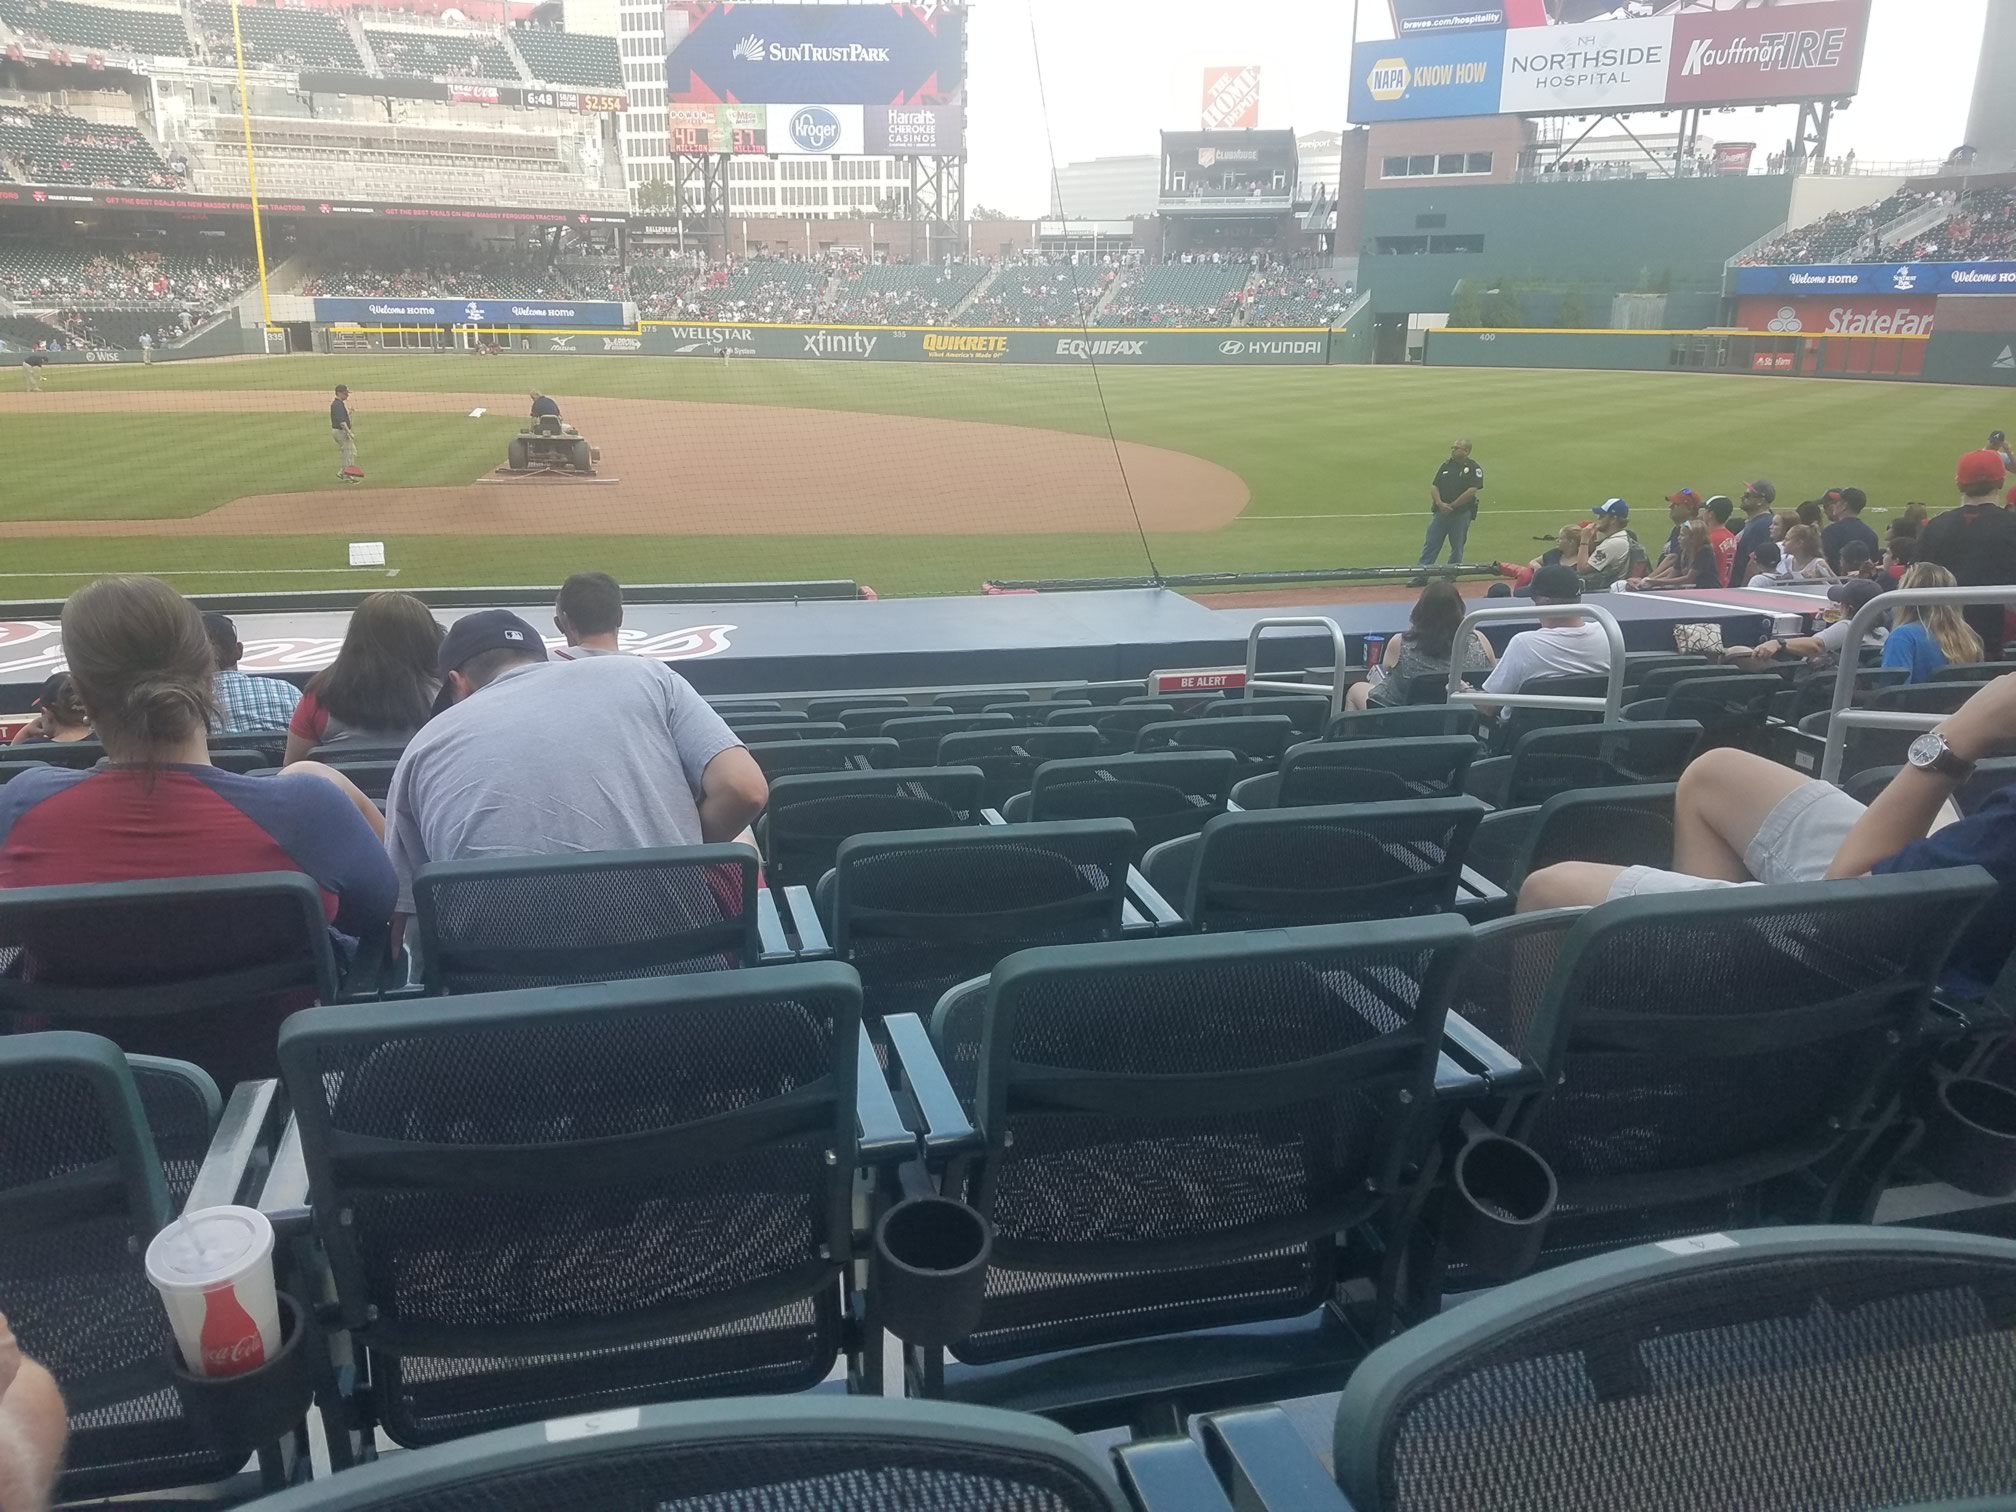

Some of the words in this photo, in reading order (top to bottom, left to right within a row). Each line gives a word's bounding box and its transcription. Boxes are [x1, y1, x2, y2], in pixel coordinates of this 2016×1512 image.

[1403, 13, 1500, 29] braves.com/hospitality
[1511, 45, 1663, 73] NORTHSIDE
[1681, 38, 1785, 76] Kauffman
[1760, 27, 1847, 71] TIRE
[127, 58, 149, 76] 42
[1413, 64, 1454, 87] KNOW
[1455, 61, 1488, 84] HOW
[1374, 68, 1404, 90] NAPA
[1535, 71, 1631, 89] HOSPITAL
[527, 92, 553, 105] 6:48
[585, 95, 621, 111] $2,554
[1202, 67, 1260, 128] HOME
[675, 128, 697, 145] 40
[733, 128, 755, 145] 37
[795, 113, 837, 147] Kroger
[888, 125, 936, 134] CHEROKEE
[888, 135, 936, 143] CASINOS
[676, 144, 709, 152] MILLION
[733, 145, 766, 153] MILLION
[1215, 149, 1257, 160] CLUBHOUSE
[1789, 272, 1826, 284] Welcome
[1951, 270, 1997, 283] Welcome
[1998, 272, 2016, 283] HO
[369, 304, 406, 315] Welcome
[512, 306, 547, 317] Welcome
[642, 325, 657, 333] 375
[1825, 307, 1935, 336] StateFar
[267, 333, 283, 341] 335
[671, 327, 752, 343] WELLSTAR
[923, 333, 1008, 351] QUIKRETE
[1479, 333, 1496, 342] 400
[734, 347, 756, 355] System
[804, 330, 877, 357] xfinity
[1055, 338, 1145, 359] EQUIFAX
[1248, 341, 1321, 354] HYUNDAI
[1181, 678, 1195, 688] BE
[1196, 675, 1228, 687] ALERT
